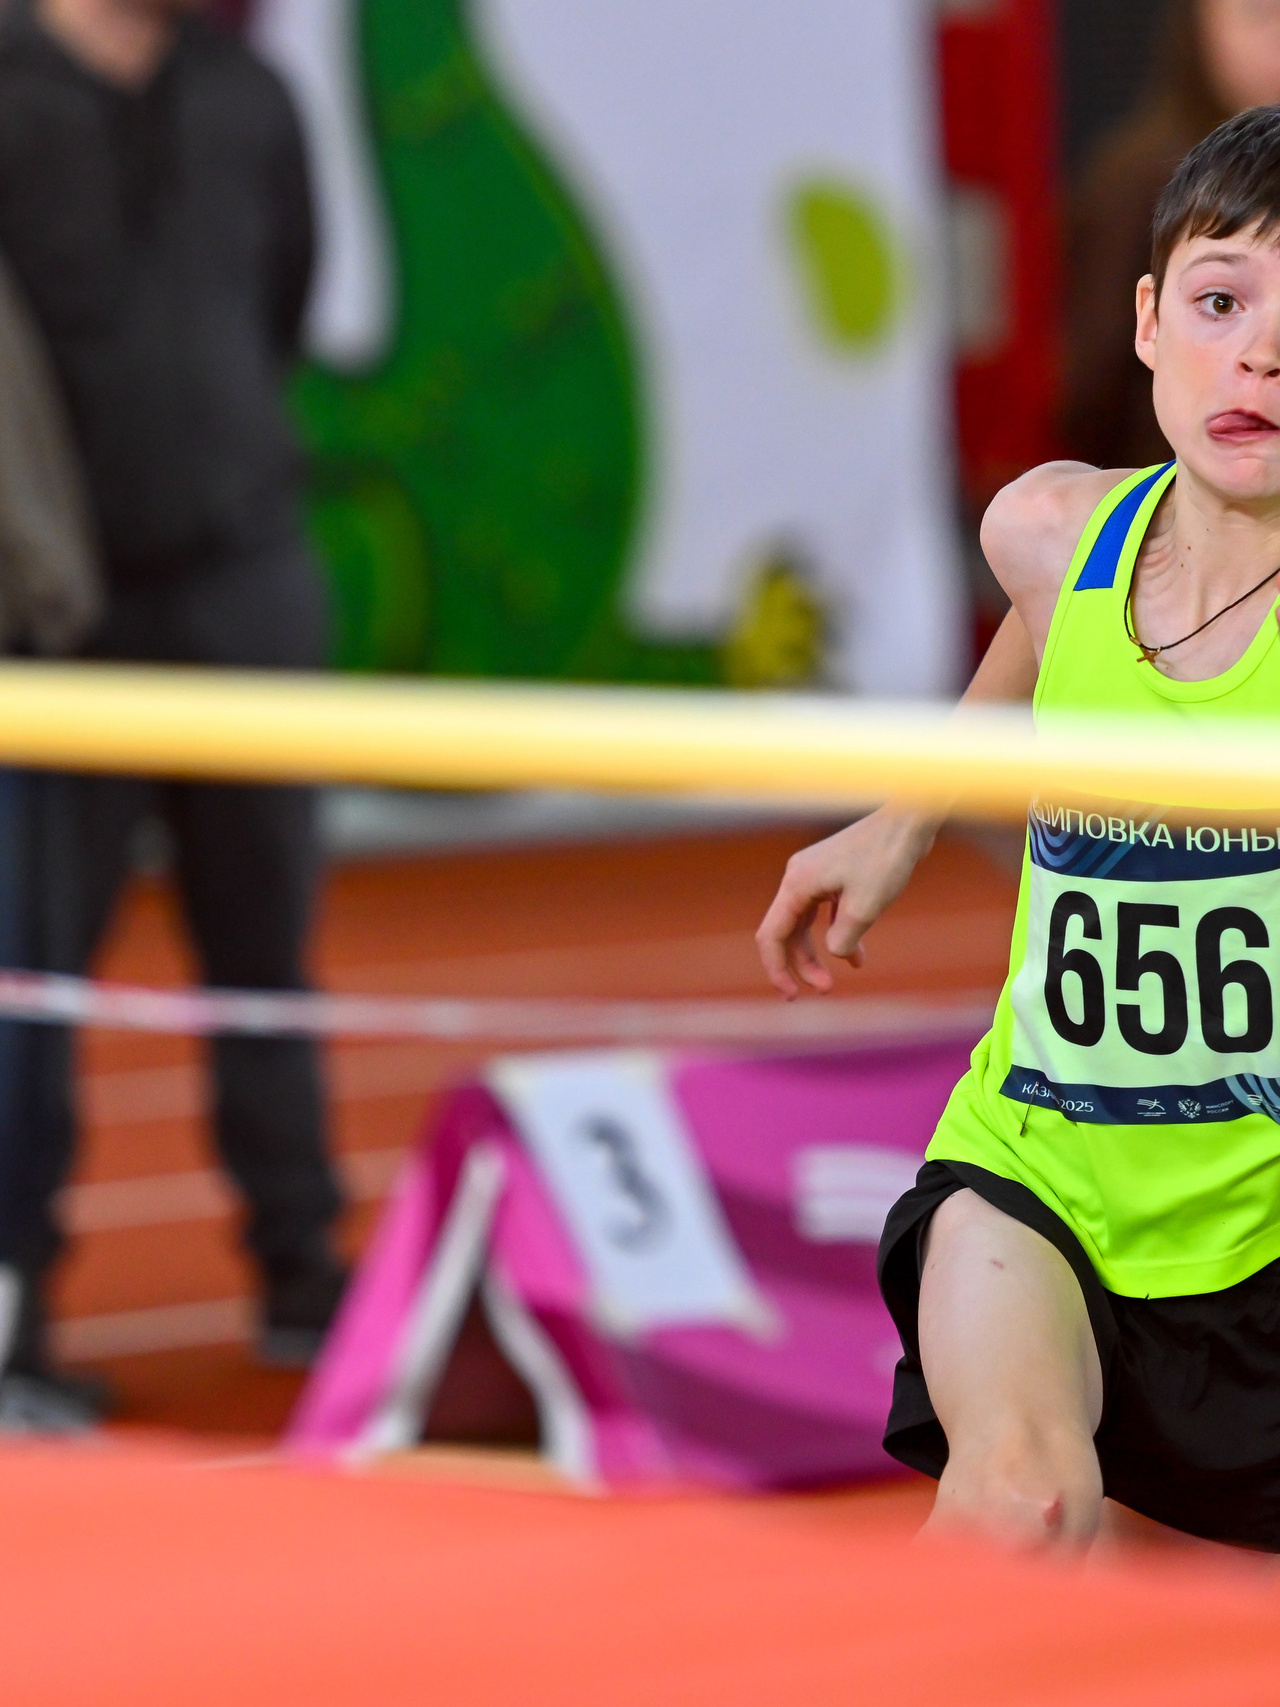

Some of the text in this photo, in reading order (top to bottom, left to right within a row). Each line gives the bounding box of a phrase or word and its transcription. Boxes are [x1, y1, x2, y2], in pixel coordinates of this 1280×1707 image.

[1044, 890, 1273, 1056] 656
[1059, 1099, 1094, 1113] 2025
[578, 1114, 670, 1256] 3
